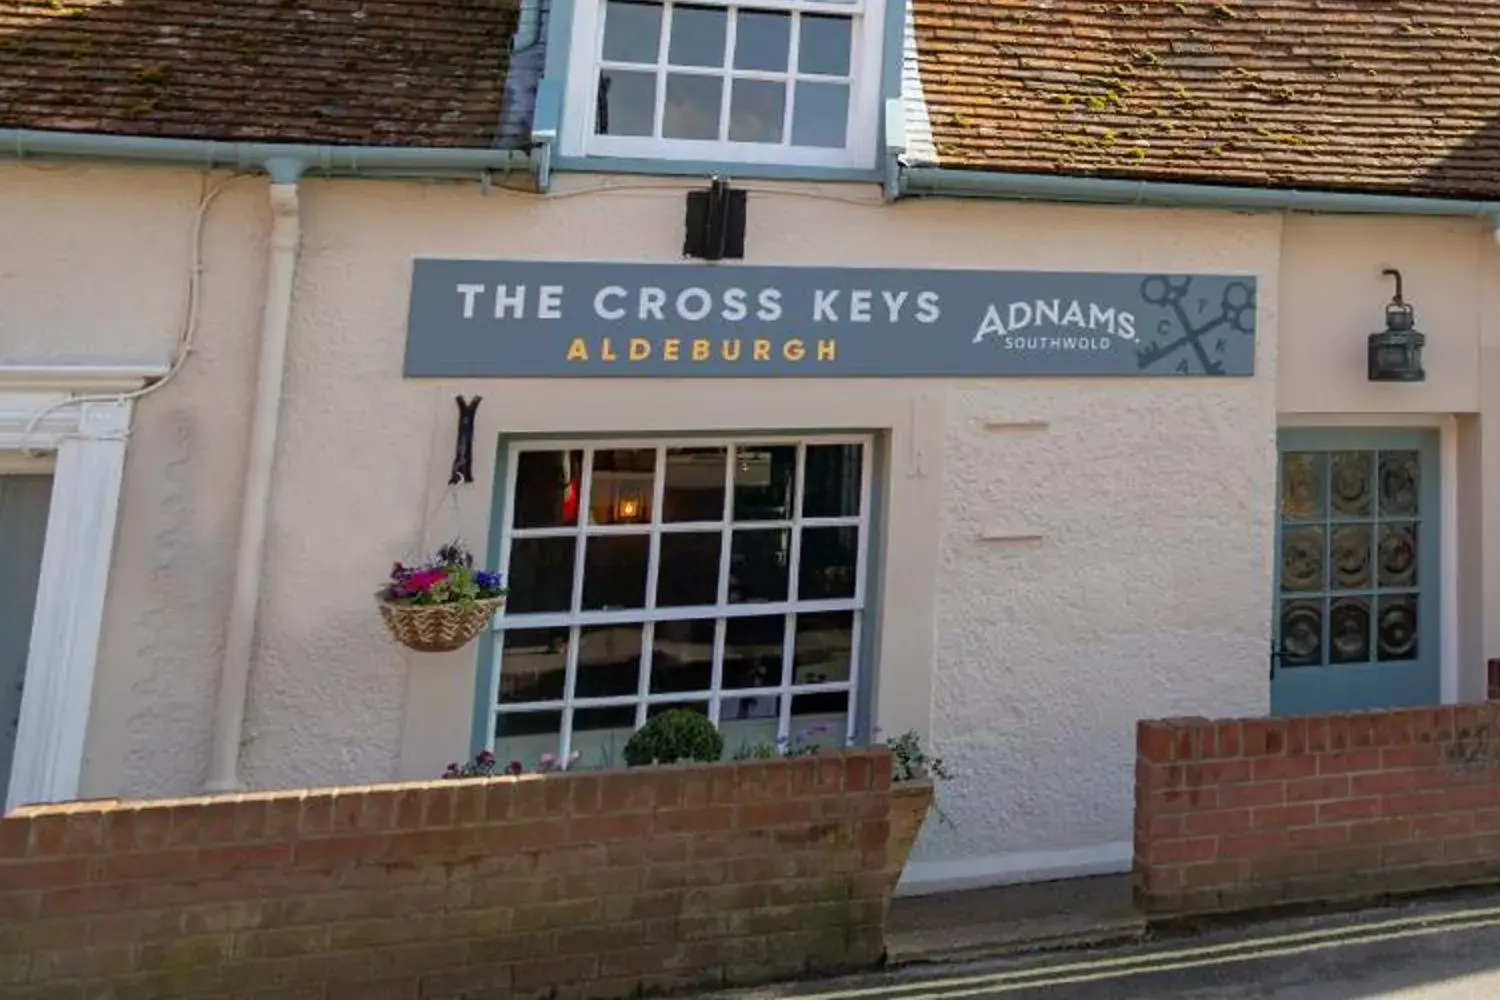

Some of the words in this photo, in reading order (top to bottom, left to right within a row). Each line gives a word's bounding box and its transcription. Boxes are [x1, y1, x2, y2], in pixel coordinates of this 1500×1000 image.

[456, 284, 564, 319] THE
[593, 285, 784, 321] CROSS
[812, 289, 941, 323] KEYS
[972, 299, 1137, 343] ADNAMS
[565, 337, 836, 361] ALDEBURGH
[1004, 336, 1110, 350] SOUTHWOLD
